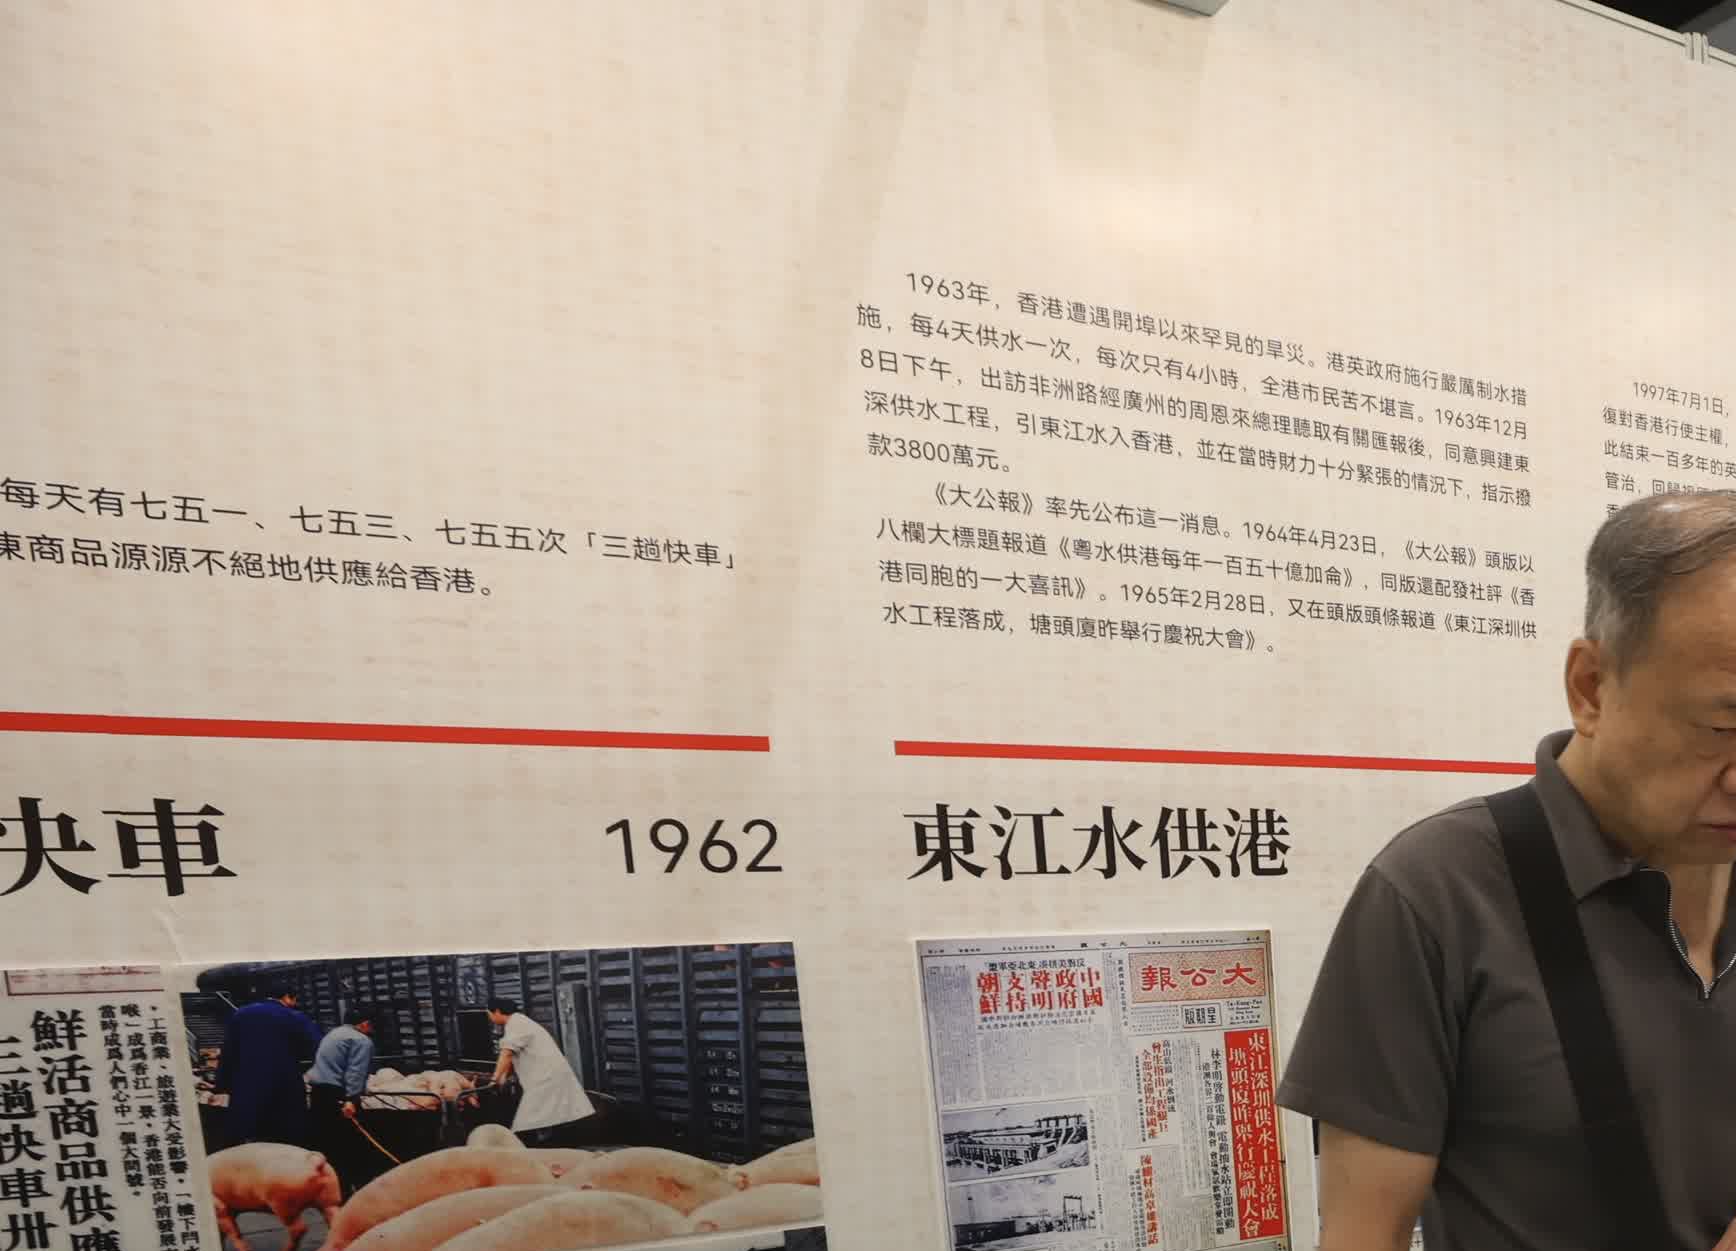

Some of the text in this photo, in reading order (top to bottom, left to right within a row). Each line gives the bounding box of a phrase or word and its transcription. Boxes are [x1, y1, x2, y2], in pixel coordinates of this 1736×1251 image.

[867, 433, 1010, 473] 款3800萬元。
[0, 477, 738, 570] 每天有七五一、七五三、七五五次「三趟快車」
[603, 817, 784, 876] 1962
[903, 802, 1292, 883] 東江水供港
